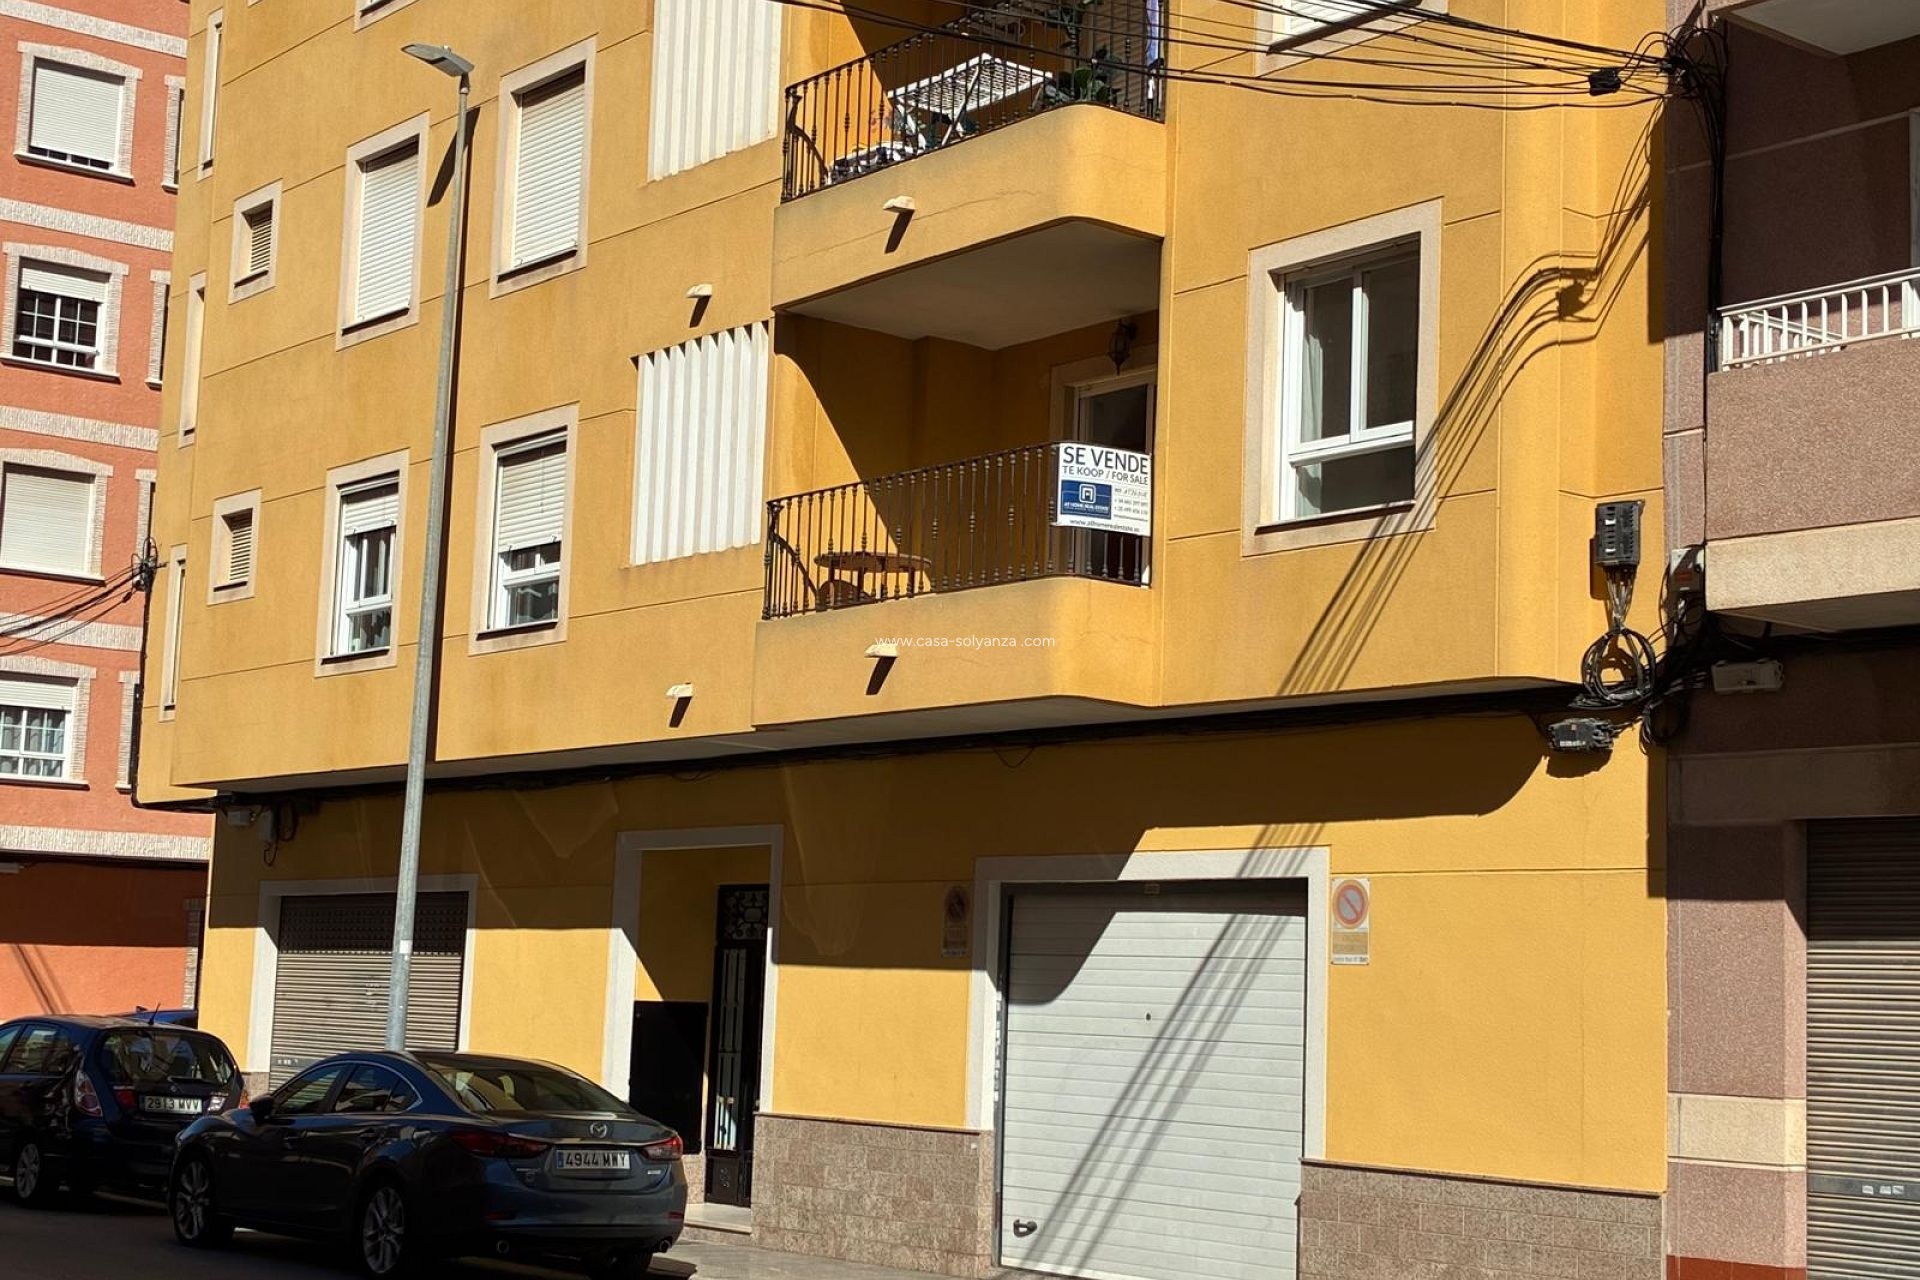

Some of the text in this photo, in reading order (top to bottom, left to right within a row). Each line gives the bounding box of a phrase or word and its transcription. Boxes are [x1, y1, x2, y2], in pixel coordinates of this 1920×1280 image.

[1063, 446, 1148, 475] SE VENDE
[1062, 466, 1074, 475] TE
[1077, 466, 1104, 478] KOOP
[1111, 471, 1129, 482] FOR
[1130, 475, 1148, 485] SALE
[566, 1152, 599, 1167] 4944
